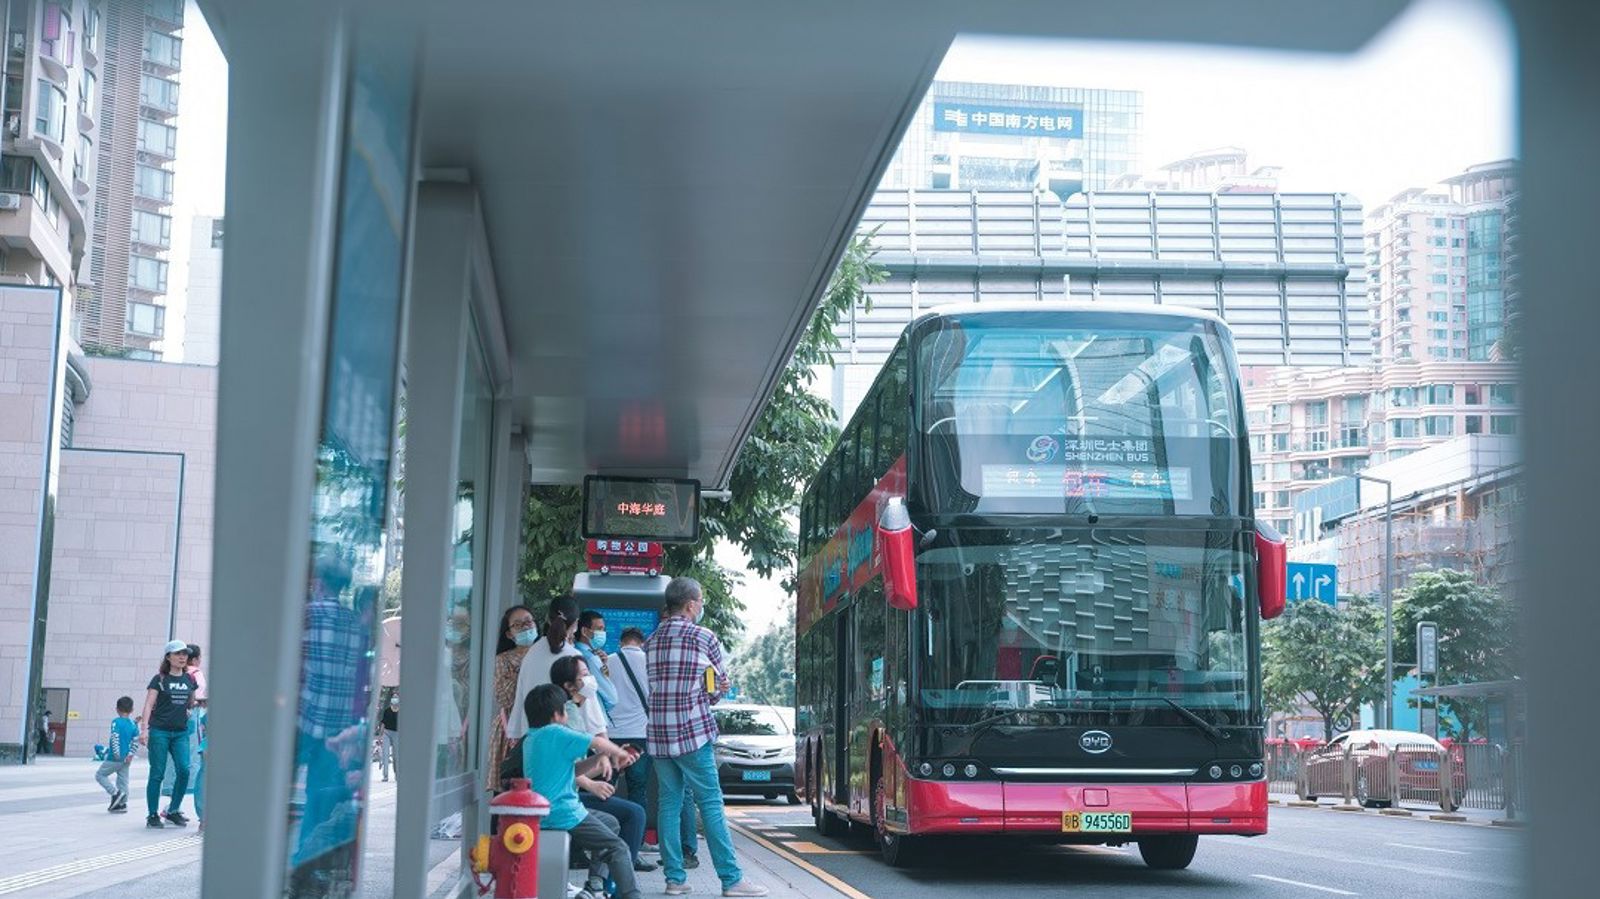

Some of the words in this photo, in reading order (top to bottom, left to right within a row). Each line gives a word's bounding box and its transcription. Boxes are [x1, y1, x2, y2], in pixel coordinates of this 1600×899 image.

[971, 111, 1073, 131] 中国南方电网
[1064, 439, 1148, 452] 深圳巴士集团
[1064, 452, 1124, 462] SHENZHEN
[1126, 452, 1149, 462] BUS
[617, 502, 666, 516] 中海华庭
[169, 682, 188, 690] FILA
[1082, 736, 1109, 747] BYD
[1085, 814, 1130, 830] 94556D
